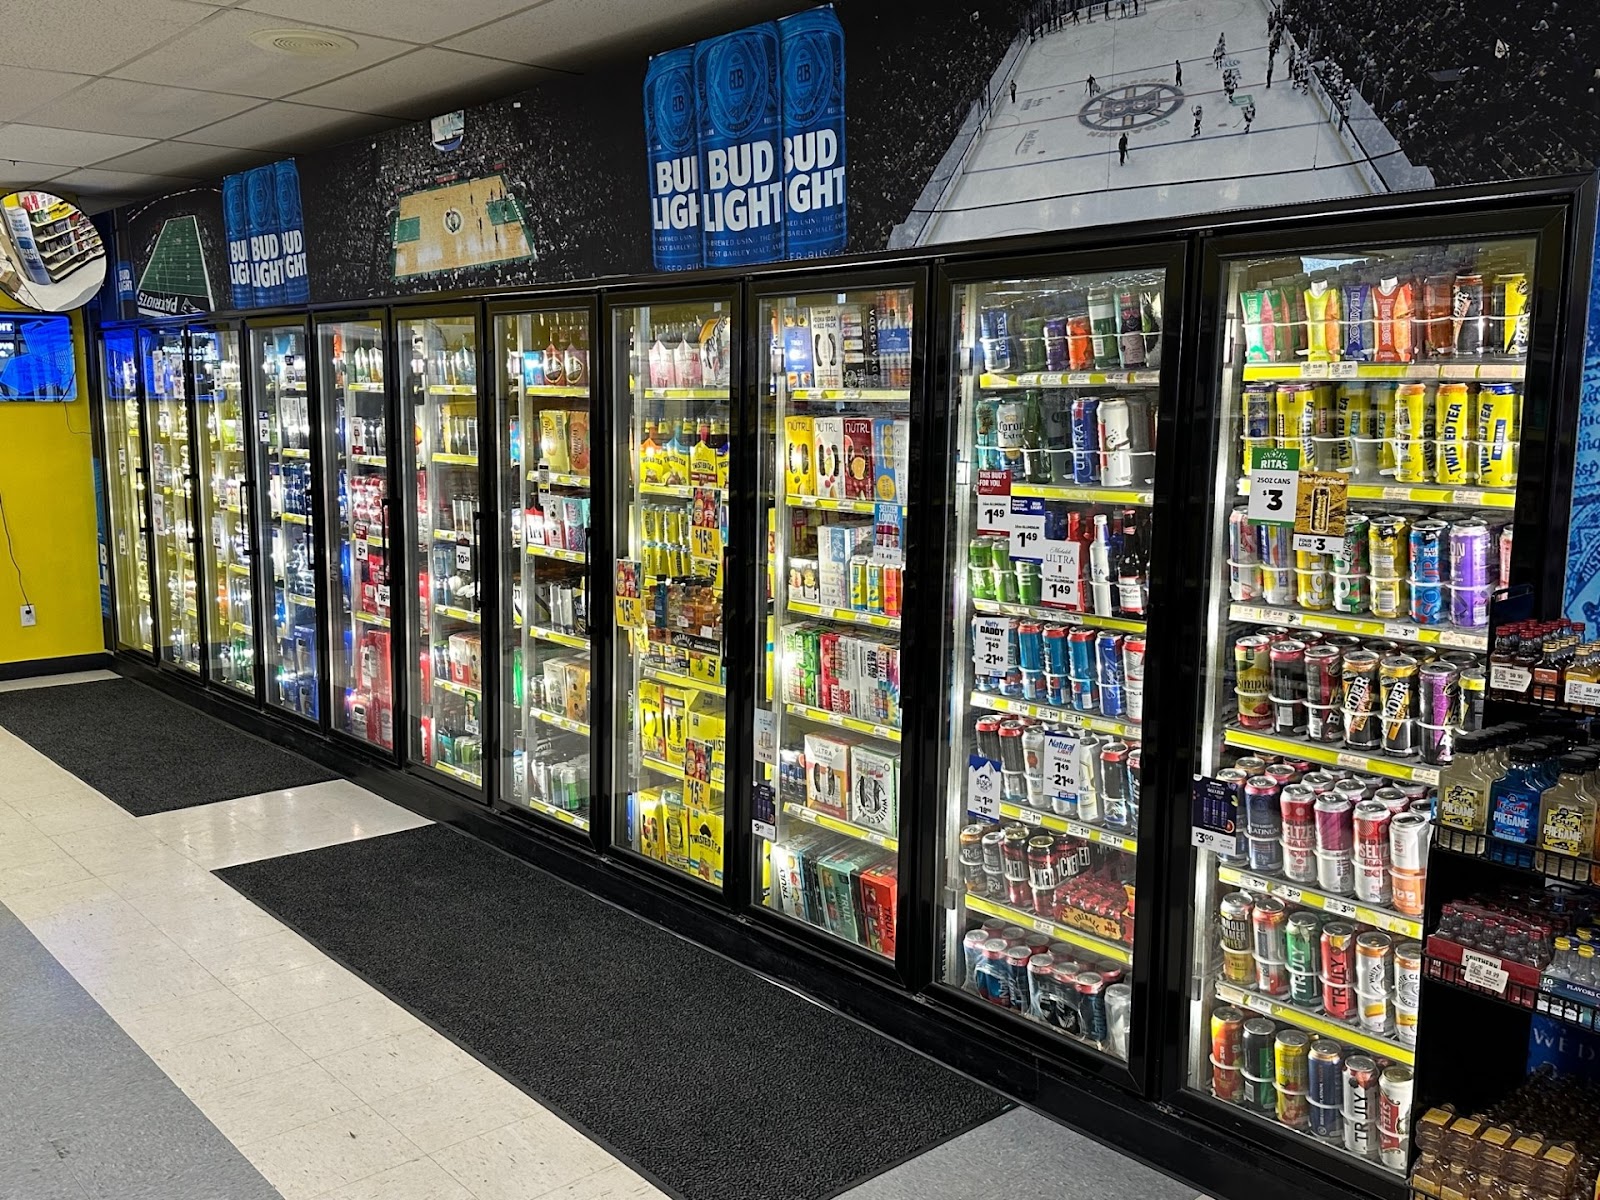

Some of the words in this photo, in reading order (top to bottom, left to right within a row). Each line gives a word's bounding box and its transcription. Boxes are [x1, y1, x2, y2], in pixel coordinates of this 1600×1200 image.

[708, 140, 774, 190] BUD
[785, 166, 845, 213] GHT
[703, 181, 783, 232] LIGHT
[251, 234, 279, 261] BUD
[119, 269, 129, 281] BUD
[250, 259, 285, 288] LIGHT
[118, 280, 132, 292] LIGHT
[137, 292, 178, 313] PATRIOTS
[1304, 401, 1315, 420] TEA
[1340, 397, 1350, 416] TEA
[1446, 403, 1463, 423] TEA
[1480, 403, 1494, 423] TEA
[1339, 418, 1350, 463] TWITED
[1444, 425, 1462, 475] TWISED
[1480, 425, 1493, 475] TWISED
[693, 461, 706, 469] TWISTED
[1261, 460, 1288, 469] RITAS
[1263, 490, 1283, 511] $3
[1046, 554, 1075, 565] ULTRA
[980, 626, 1004, 636] DADDY
[984, 620, 999, 628] Natty
[708, 659, 716, 679] TEA
[1238, 677, 1270, 694] Simply
[1048, 739, 1075, 751] Natural
[976, 778, 993, 788] BUSCH
[877, 798, 888, 824] WHITE
[1442, 801, 1476, 818] PREGAME
[1493, 811, 1530, 829] PREGAME
[1543, 824, 1582, 842] PREGAME
[690, 834, 711, 847] TWISTED
[711, 840, 721, 855] TEA
[780, 868, 789, 899] TRULY
[840, 892, 852, 926] TRULY
[884, 906, 895, 943] TRULY
[1294, 948, 1306, 995] TRULY
[1332, 956, 1347, 1007] TRULY
[1369, 963, 1382, 983] WHITE
[1566, 984, 1595, 998] FLAVORS
[1355, 1095, 1369, 1143] TRULY
